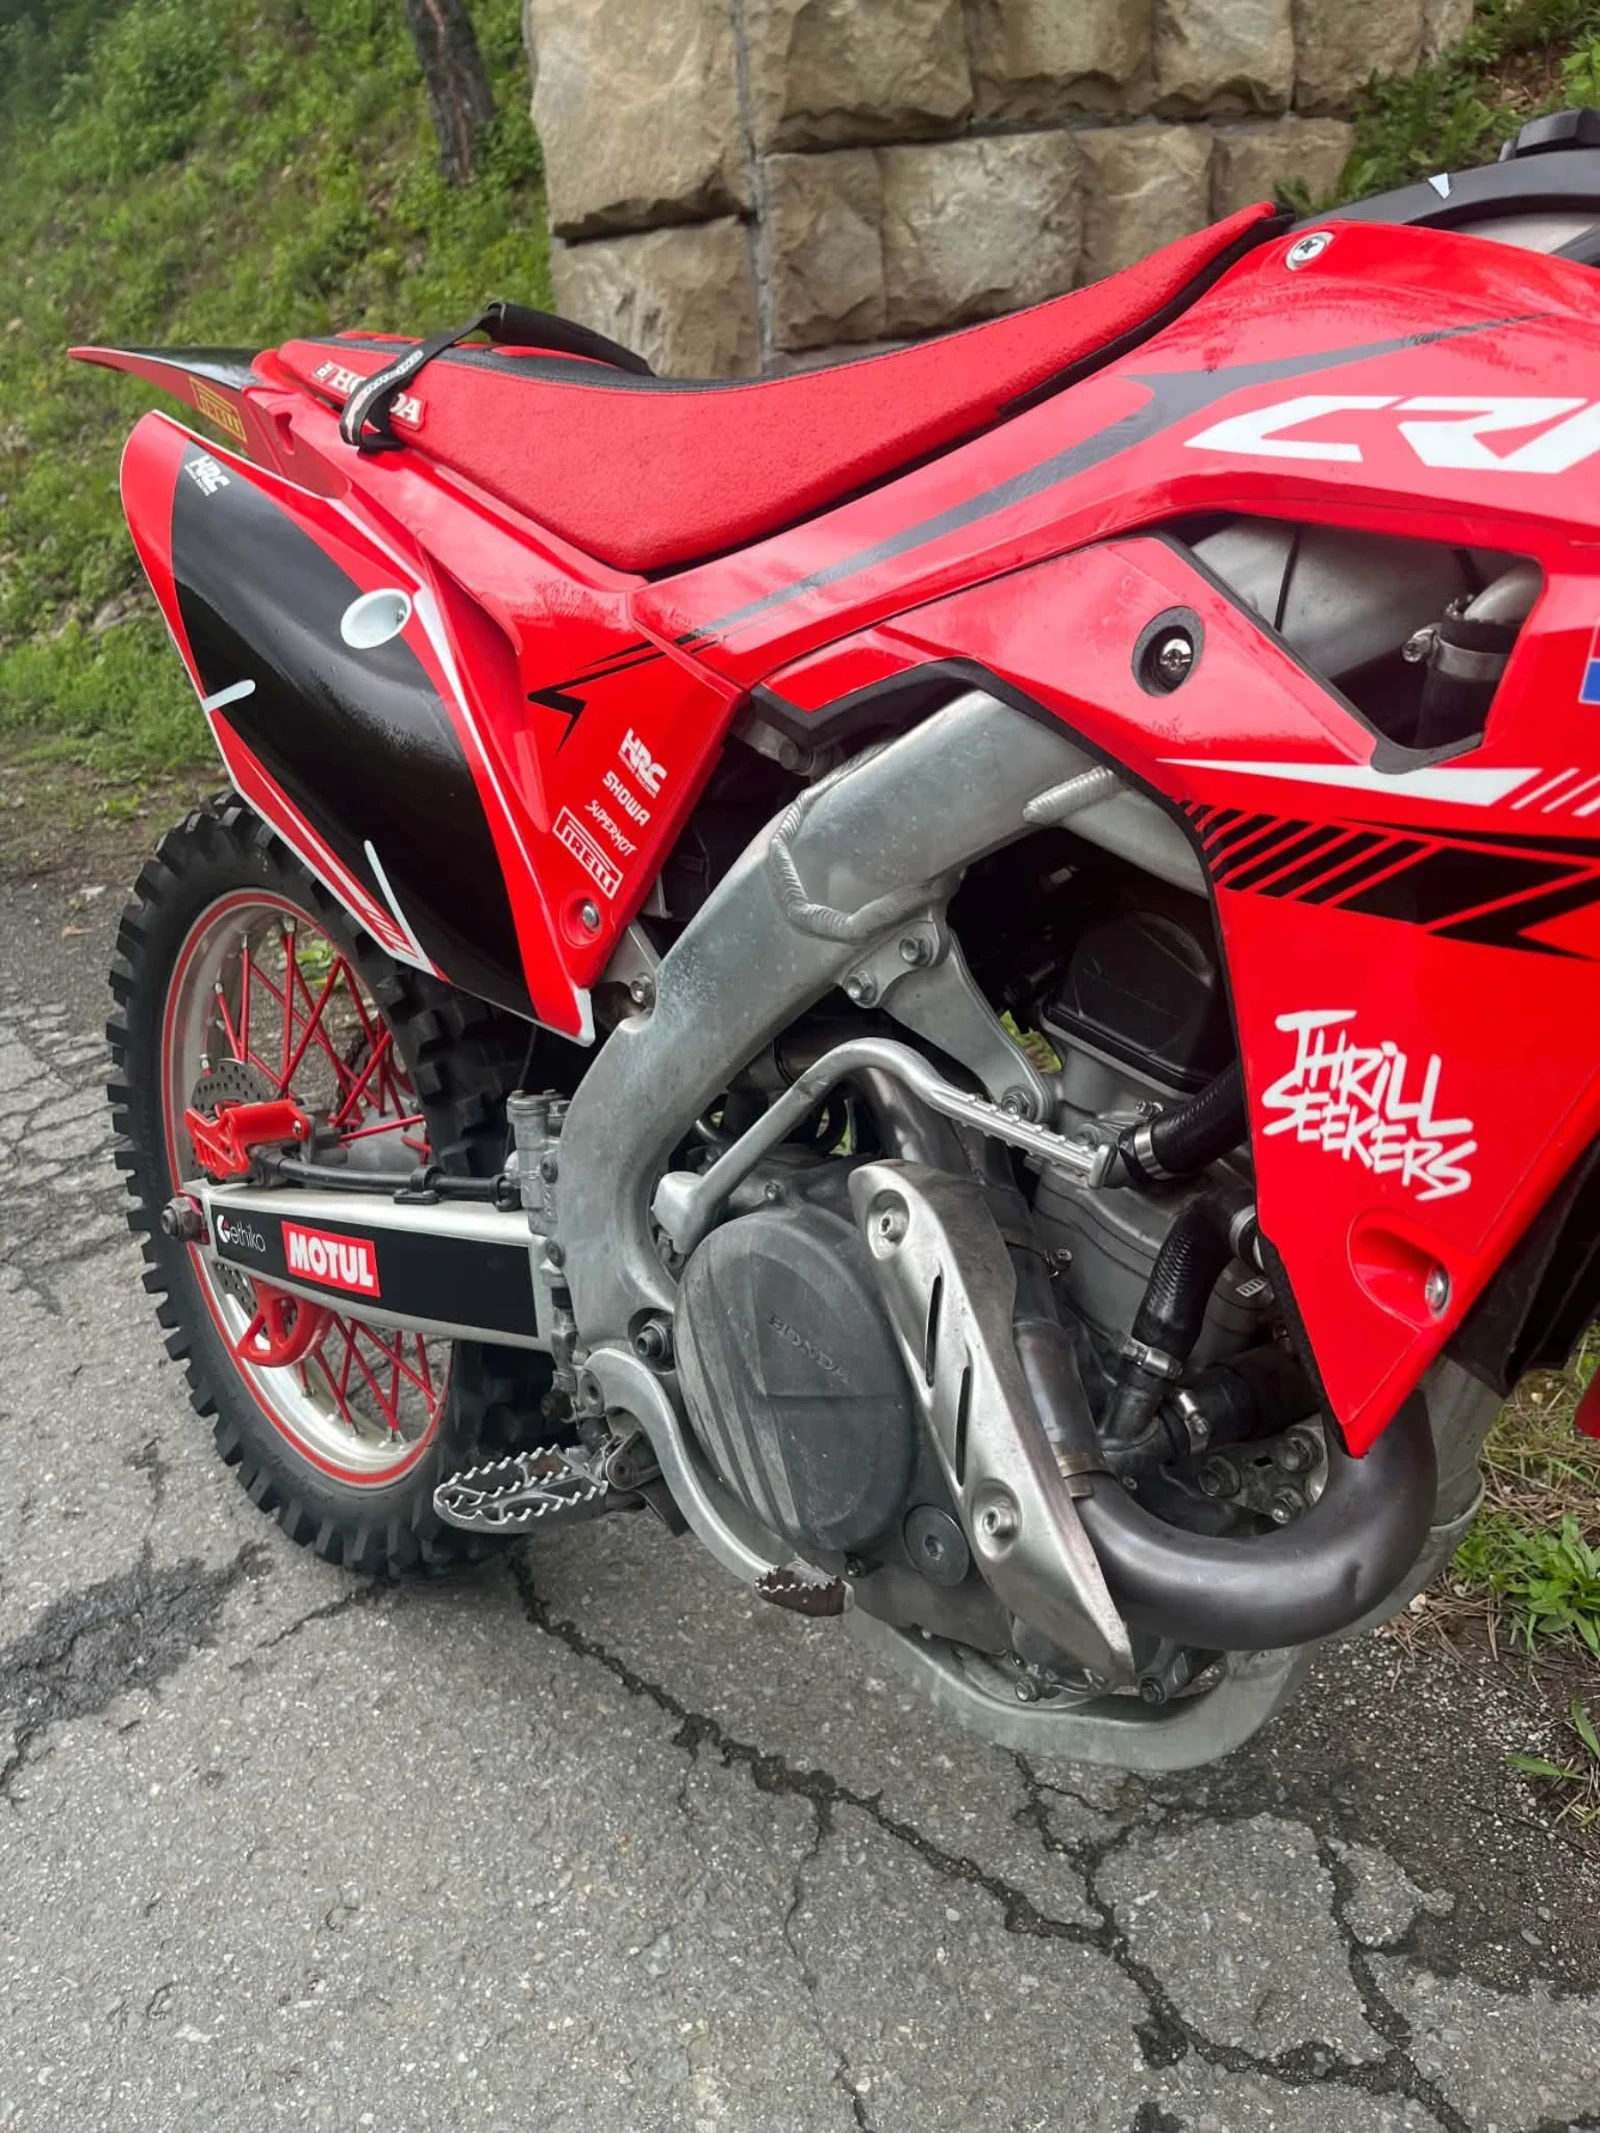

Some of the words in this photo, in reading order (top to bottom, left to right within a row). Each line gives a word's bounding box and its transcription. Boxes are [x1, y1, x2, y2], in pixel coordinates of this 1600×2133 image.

[189, 455, 231, 493] HRC
[620, 727, 668, 793] HRC
[602, 770, 651, 827] SHOWA
[556, 811, 620, 895] PIRELLI
[584, 799, 637, 856] SUPERMOT
[1262, 1068, 1477, 1201] SEEKERS
[290, 1231, 374, 1288] MOTUL
